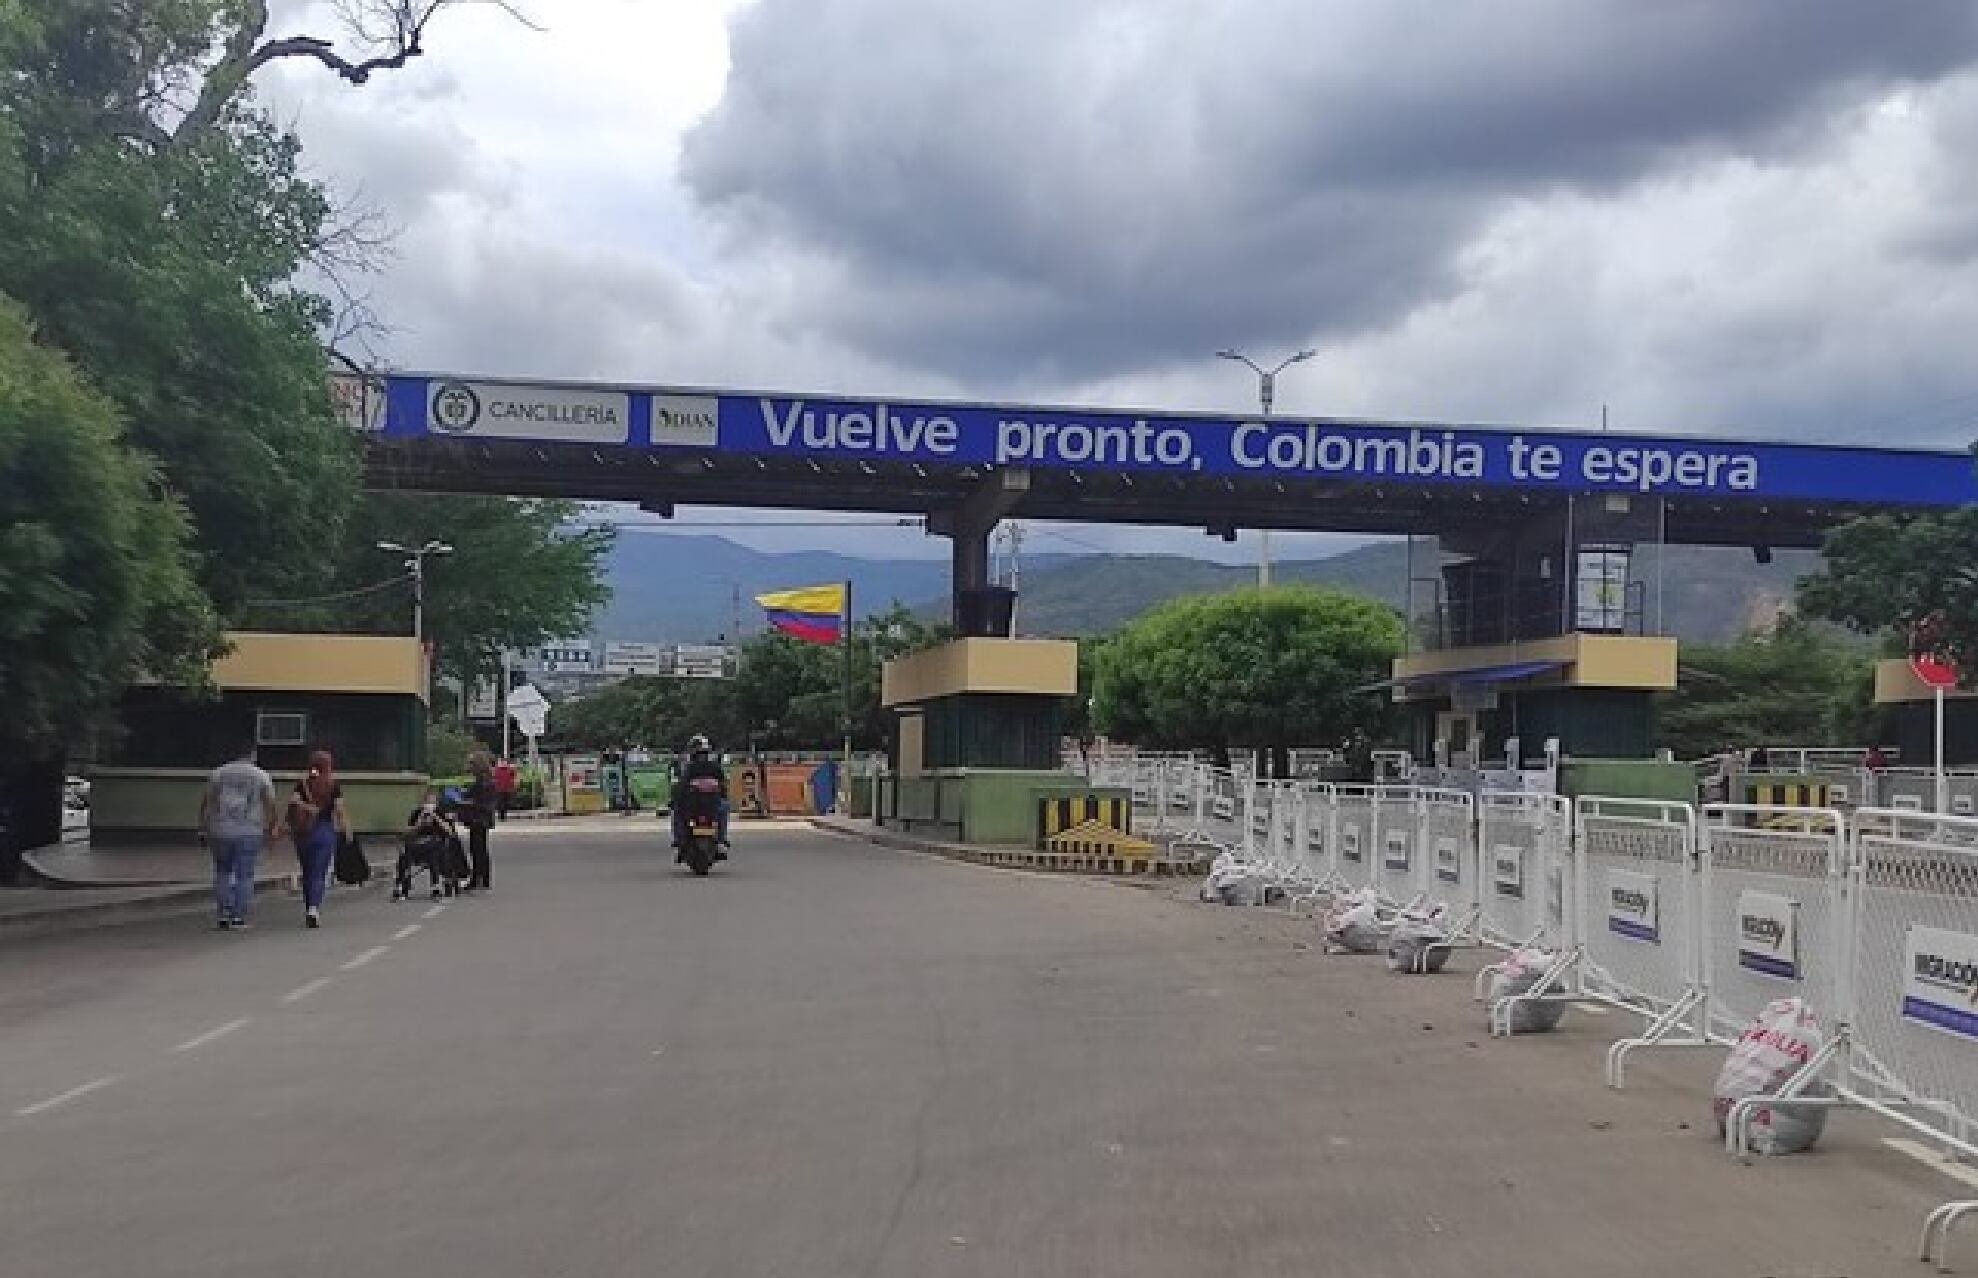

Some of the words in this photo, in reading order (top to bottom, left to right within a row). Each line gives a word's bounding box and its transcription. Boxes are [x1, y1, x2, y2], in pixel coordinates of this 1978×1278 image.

[489, 401, 618, 426] CANCILLERÍA
[760, 399, 959, 453] Vuelve
[996, 419, 1202, 471] pronto,
[1231, 422, 1484, 478] Colombia
[1508, 435, 1562, 480] te
[1581, 449, 1758, 491] espera
